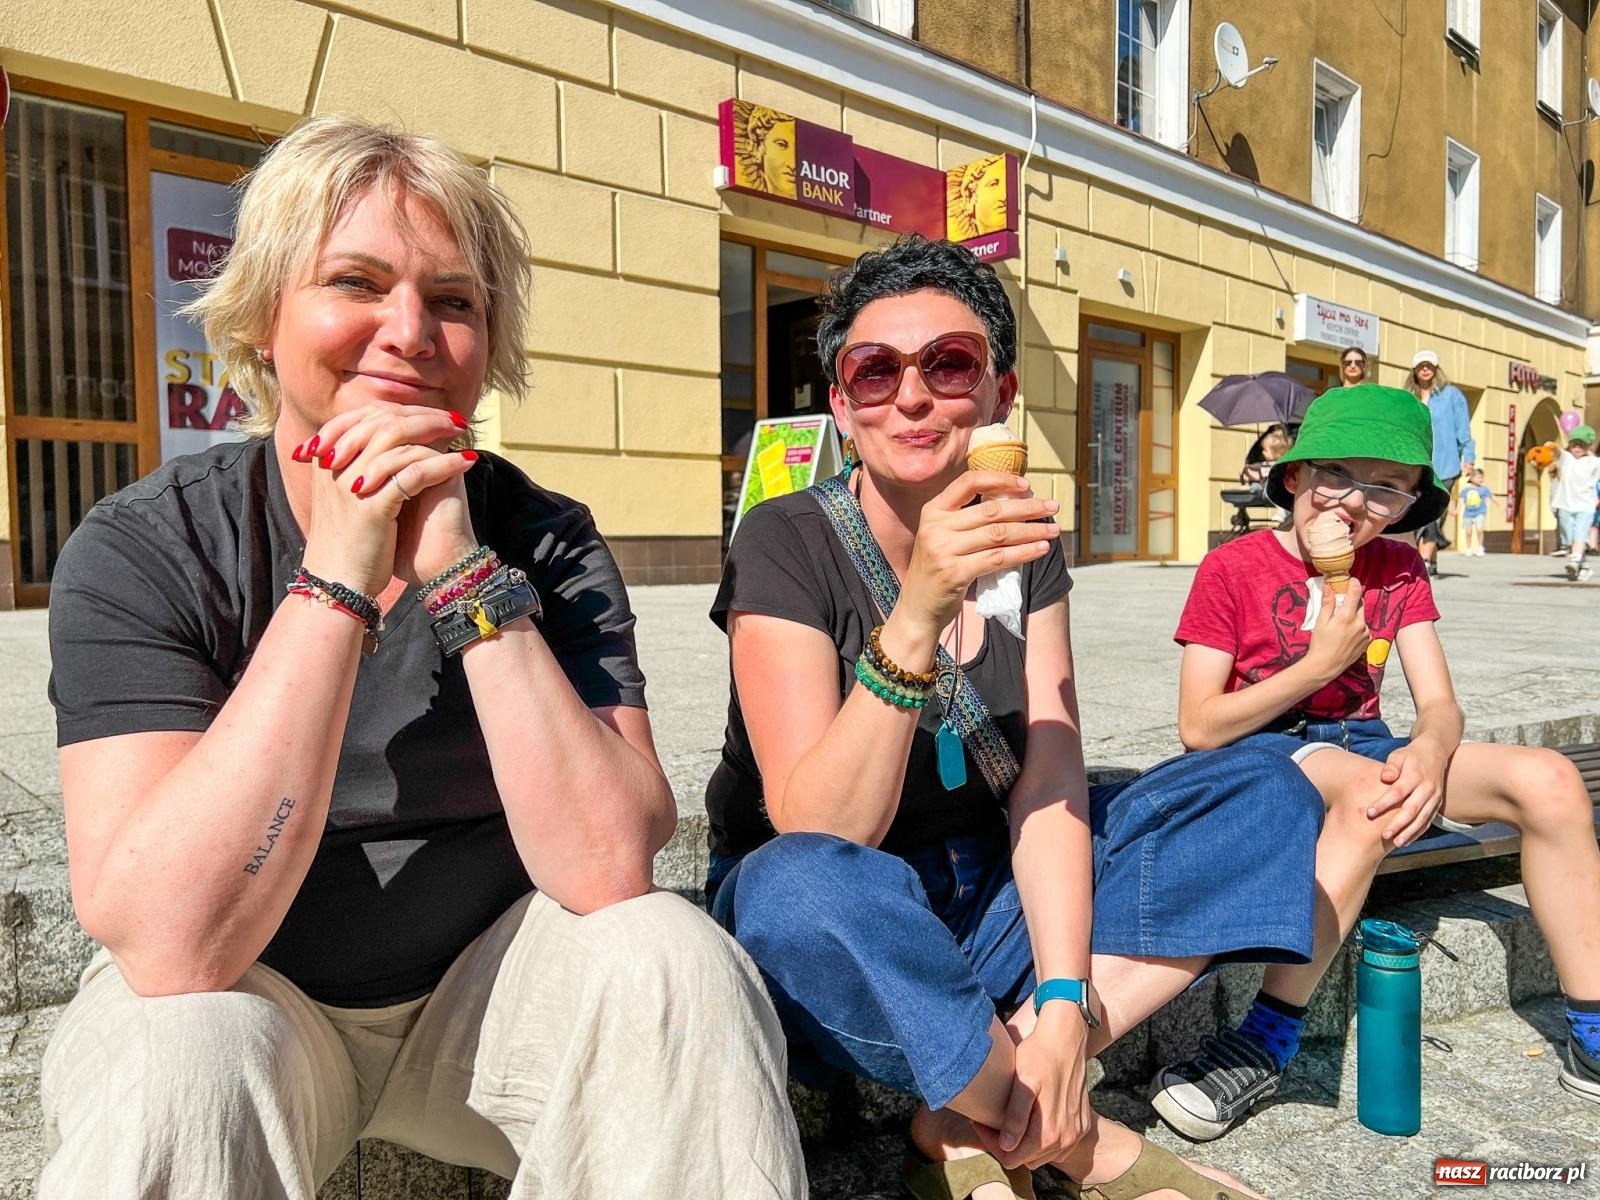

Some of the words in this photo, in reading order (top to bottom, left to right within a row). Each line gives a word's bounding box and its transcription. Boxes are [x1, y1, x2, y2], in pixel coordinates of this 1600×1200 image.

[800, 160, 851, 190] ALIOR
[802, 181, 844, 207] BANK
[854, 202, 892, 225] artner
[1114, 383, 1124, 454] CENTRUM
[1113, 459, 1123, 535] MEDYCZNE
[243, 797, 296, 876] BALANCE
